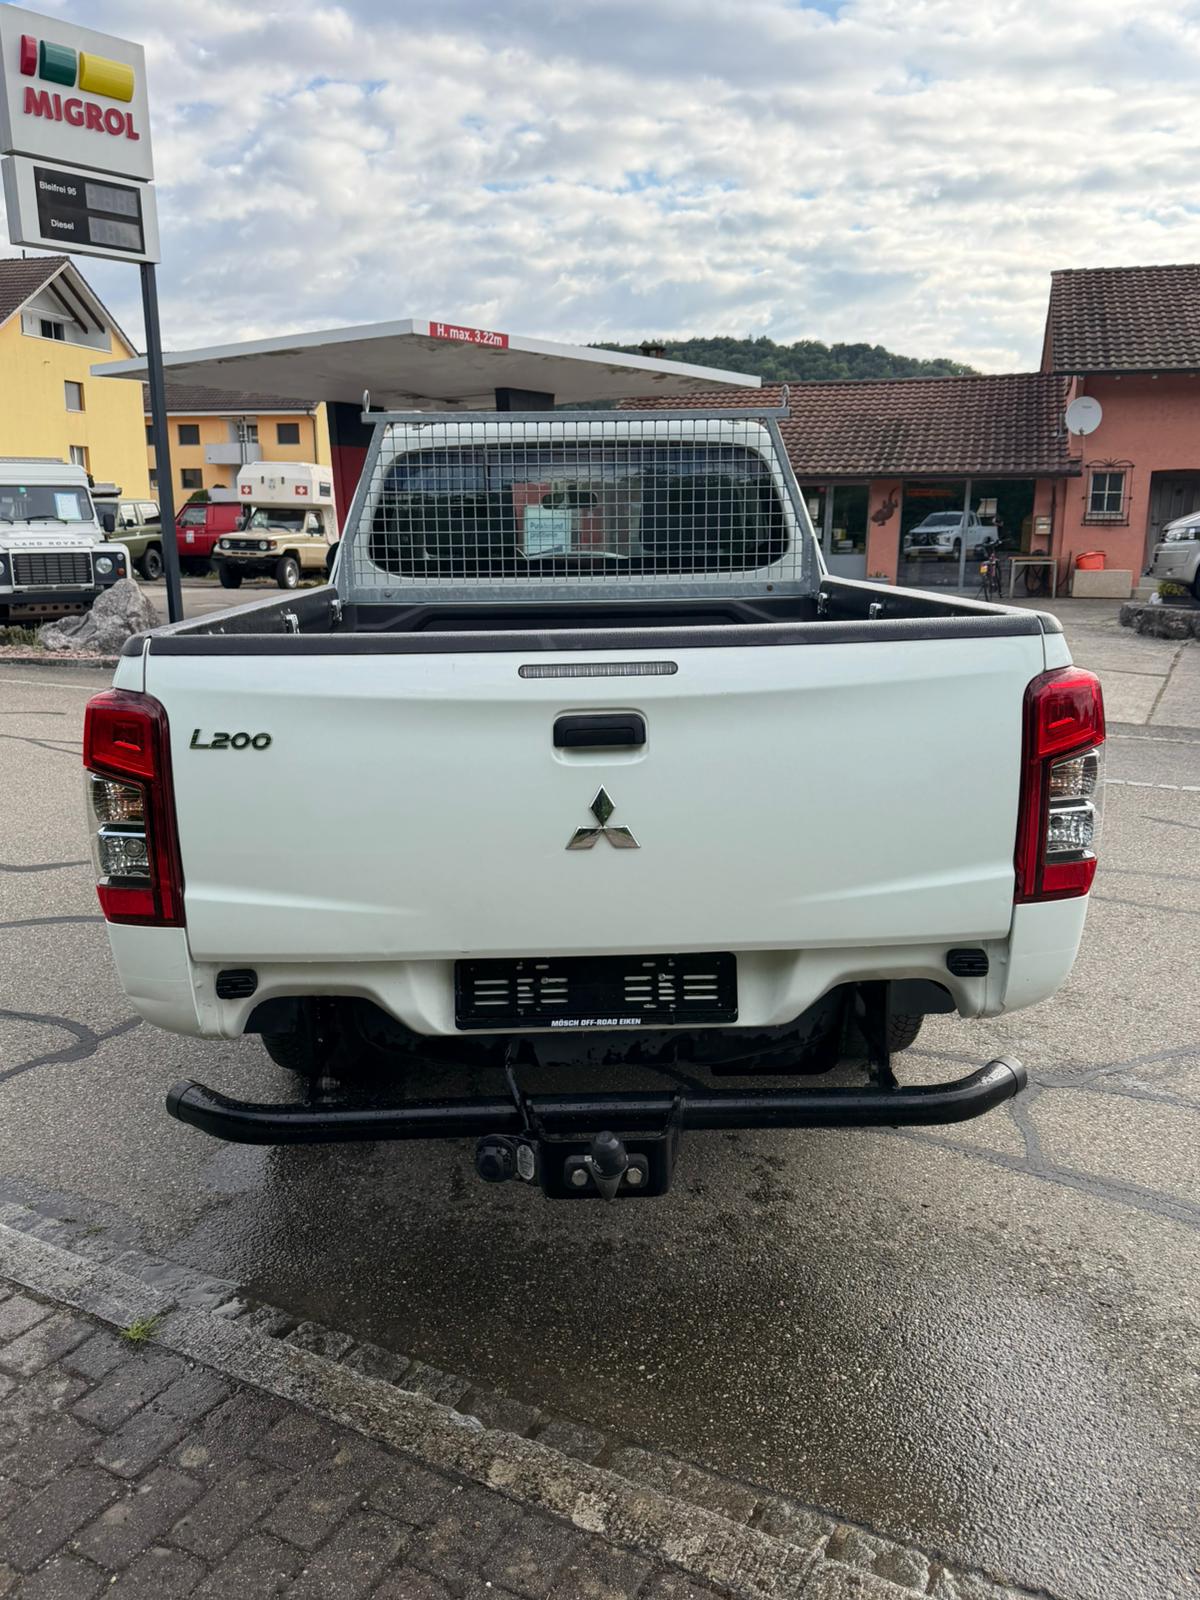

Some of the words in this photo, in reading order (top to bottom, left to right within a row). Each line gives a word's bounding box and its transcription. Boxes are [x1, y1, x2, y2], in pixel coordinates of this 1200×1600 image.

[23, 86, 139, 141] MIGROL
[39, 180, 66, 194] Bleifrei
[67, 187, 77, 196] 95
[50, 219, 74, 230] Diesel
[436, 323, 448, 337] H.
[449, 328, 473, 341] max.
[474, 330, 503, 346] 3.22m
[189, 728, 272, 751] L200
[551, 1018, 579, 1027] MÖSCH
